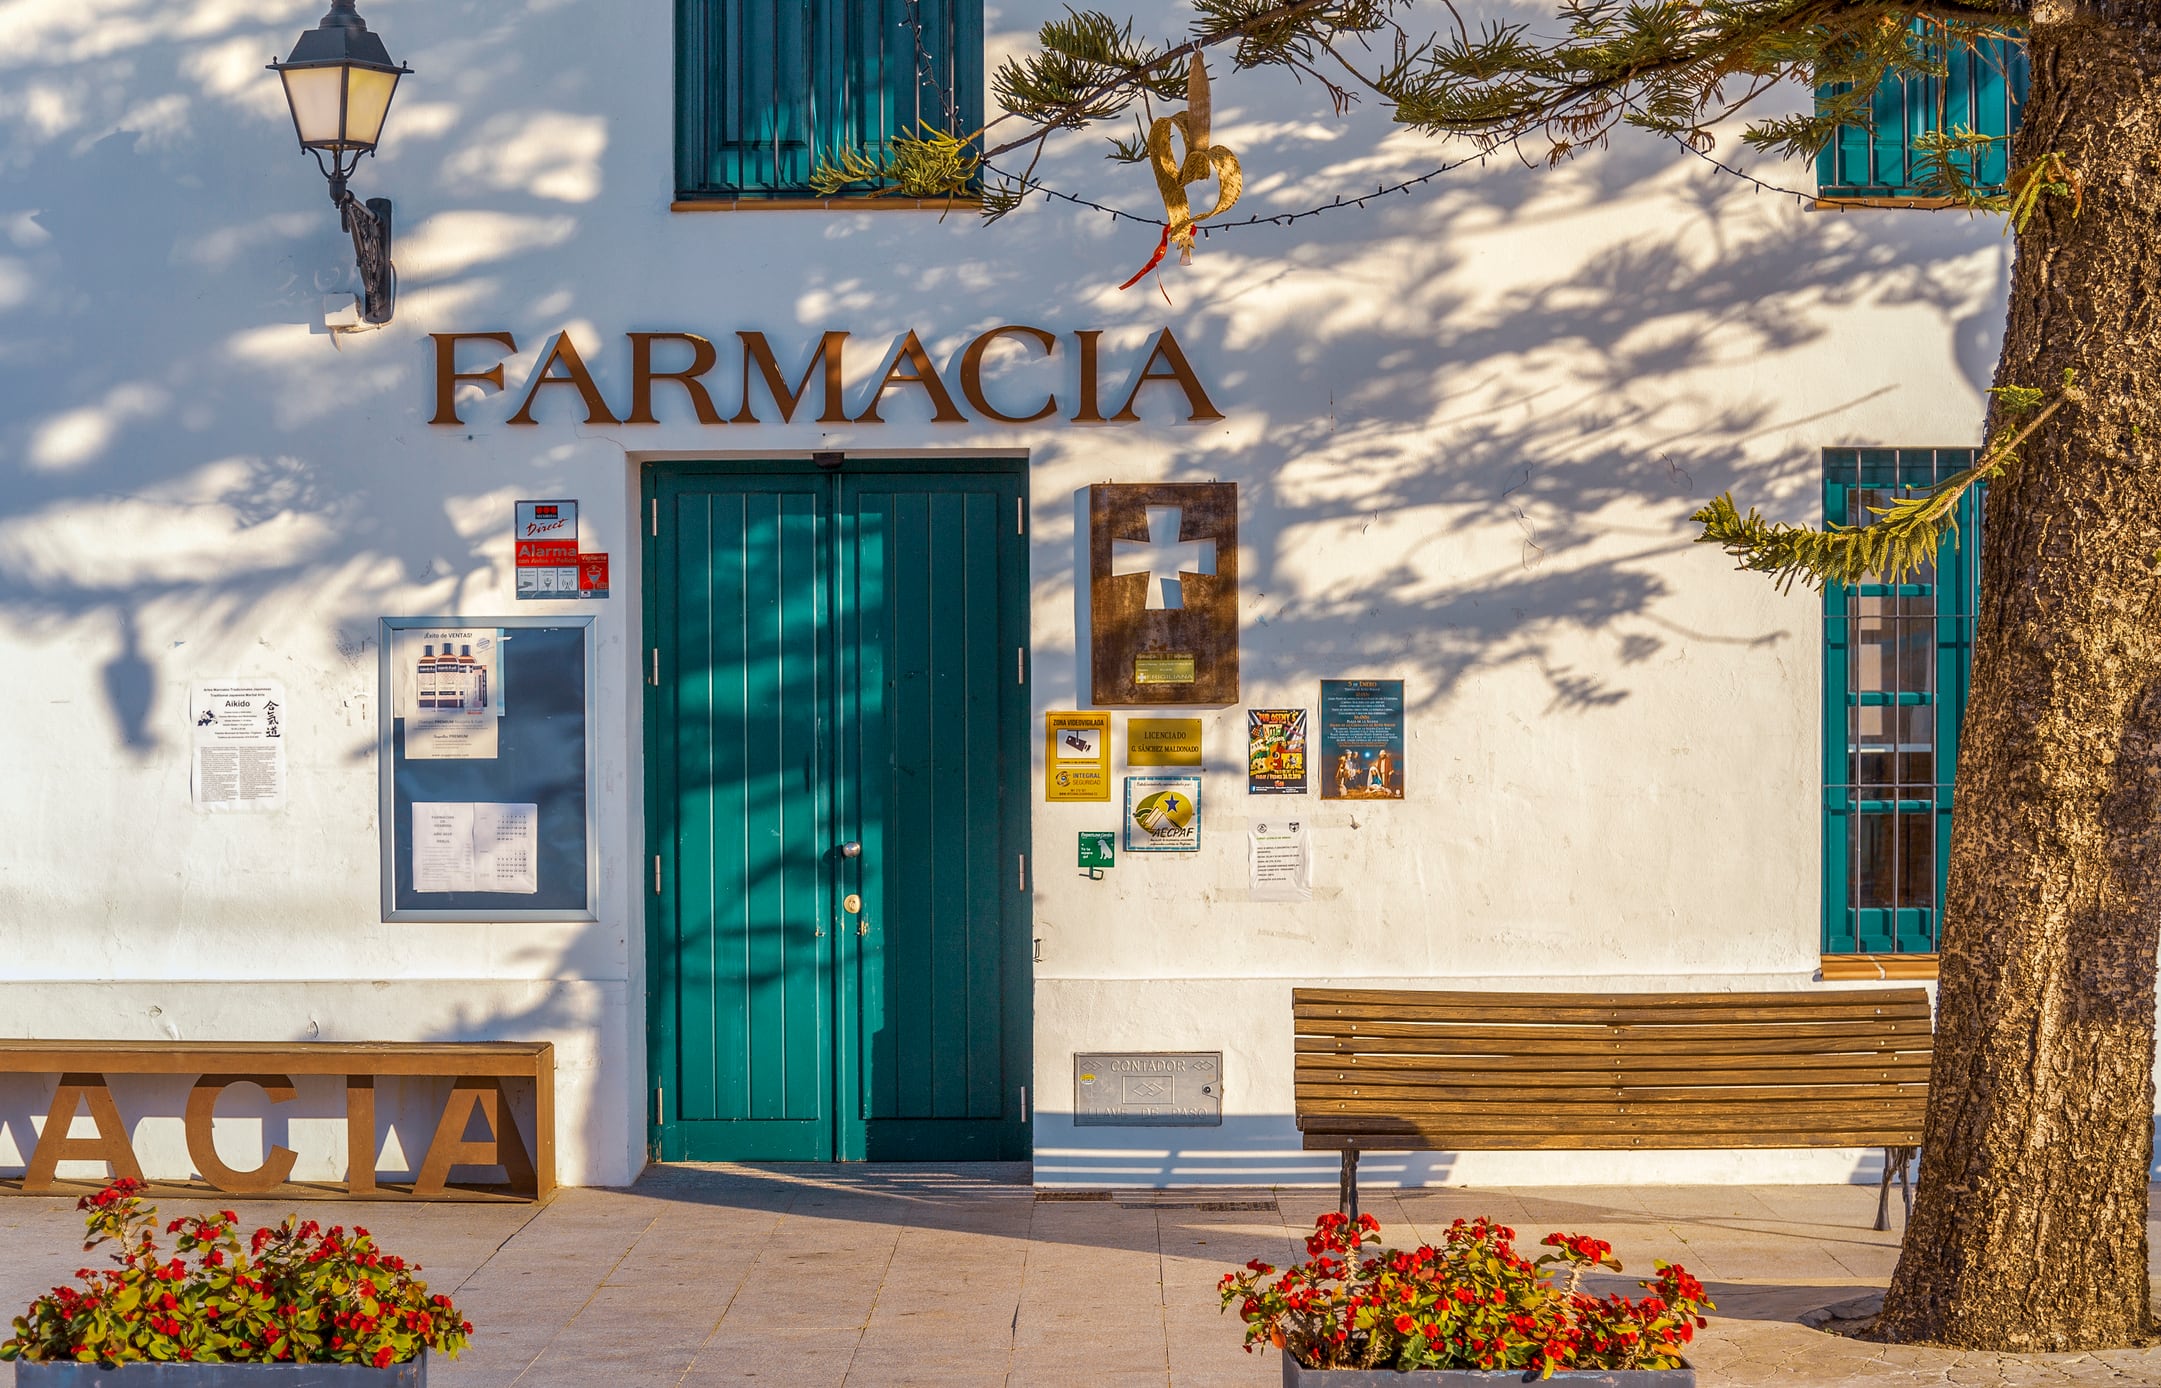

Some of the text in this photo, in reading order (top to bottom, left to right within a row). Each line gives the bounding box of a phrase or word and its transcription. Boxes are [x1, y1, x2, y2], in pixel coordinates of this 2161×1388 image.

[428, 325, 1225, 424] FARMACIA
[526, 518, 568, 536] Direct
[518, 544, 577, 557] Alarma
[1144, 731, 1187, 739] LICENCIADO
[1138, 744, 1163, 752] SÁNCHEZ
[1152, 827, 1194, 837] AECPAF
[1111, 1060, 1186, 1072] CONTADOR
[1087, 1107, 1208, 1119] LLAVE DE PASO
